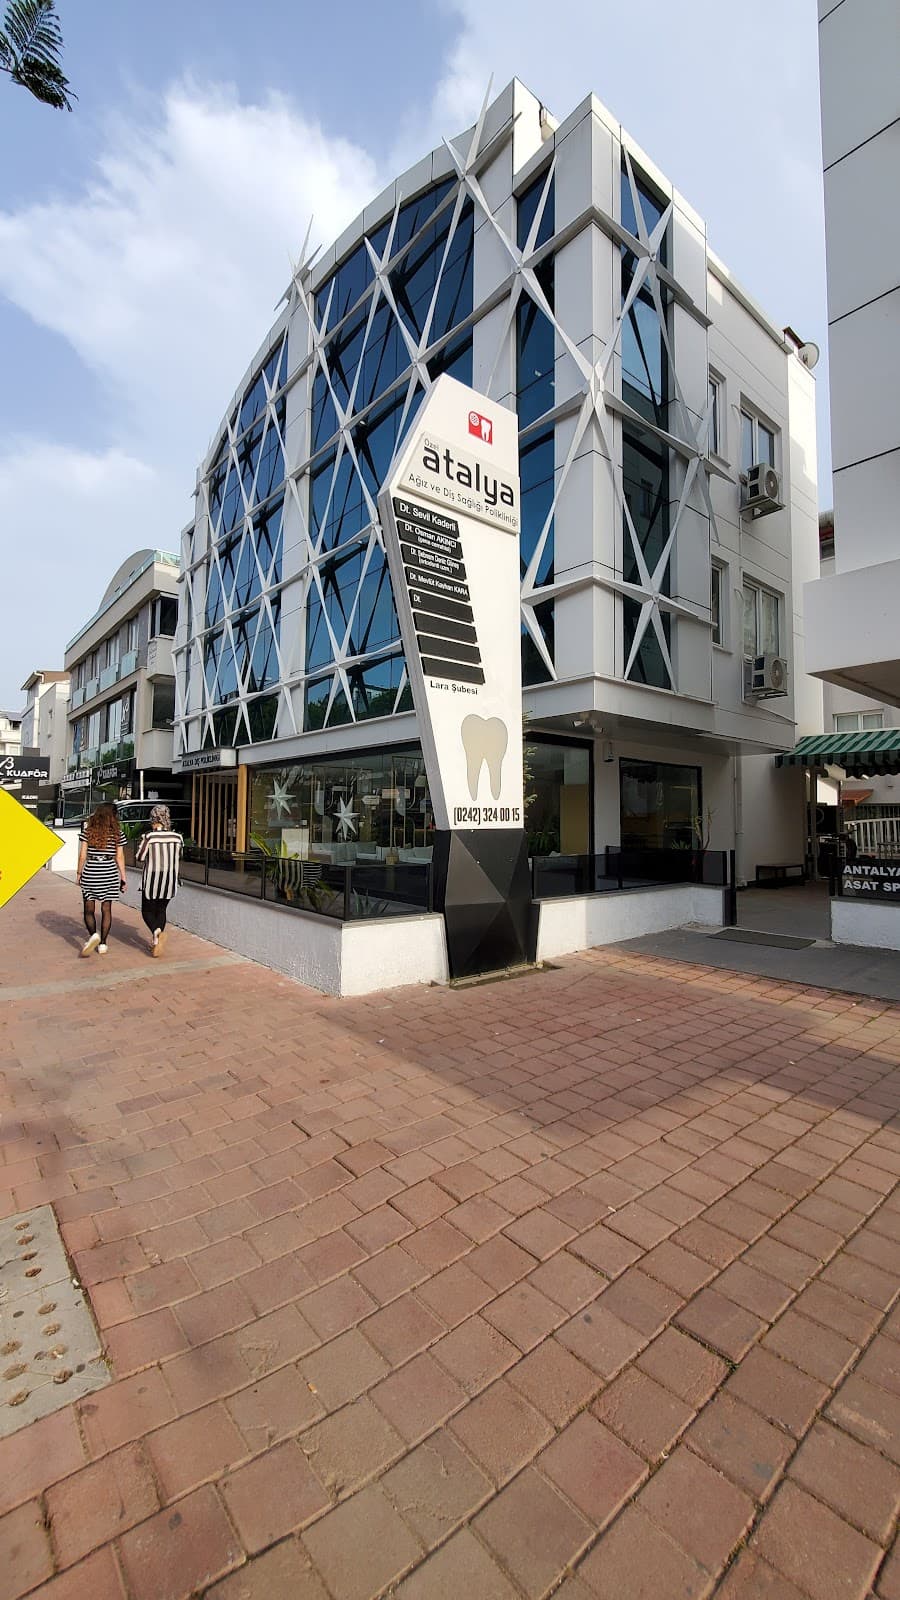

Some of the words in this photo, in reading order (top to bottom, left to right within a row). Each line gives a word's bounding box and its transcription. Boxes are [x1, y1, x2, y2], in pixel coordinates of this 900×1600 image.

[422, 445, 514, 507] atalya
[408, 472, 428, 489] Ağız
[430, 484, 441, 494] ve
[443, 487, 455, 501] Diş
[399, 501, 411, 515] Dt.
[412, 507, 431, 522] Sevil
[431, 514, 456, 532] Kaderli
[404, 523, 414, 533] Dt.
[415, 527, 436, 541] Osman
[436, 535, 457, 549] AKINCI
[409, 572, 417, 581] Dt.
[417, 574, 435, 586] Mevlüt
[453, 585, 469, 596] KARA
[413, 593, 422, 603] Dt.
[430, 680, 450, 691] Lara
[451, 682, 478, 696] Şubesi
[6, 768, 48, 778] KUAFÖR
[482, 807, 498, 822] 324
[499, 807, 510, 822] 00
[511, 807, 520, 822] 15
[844, 880, 879, 891] ASAT
